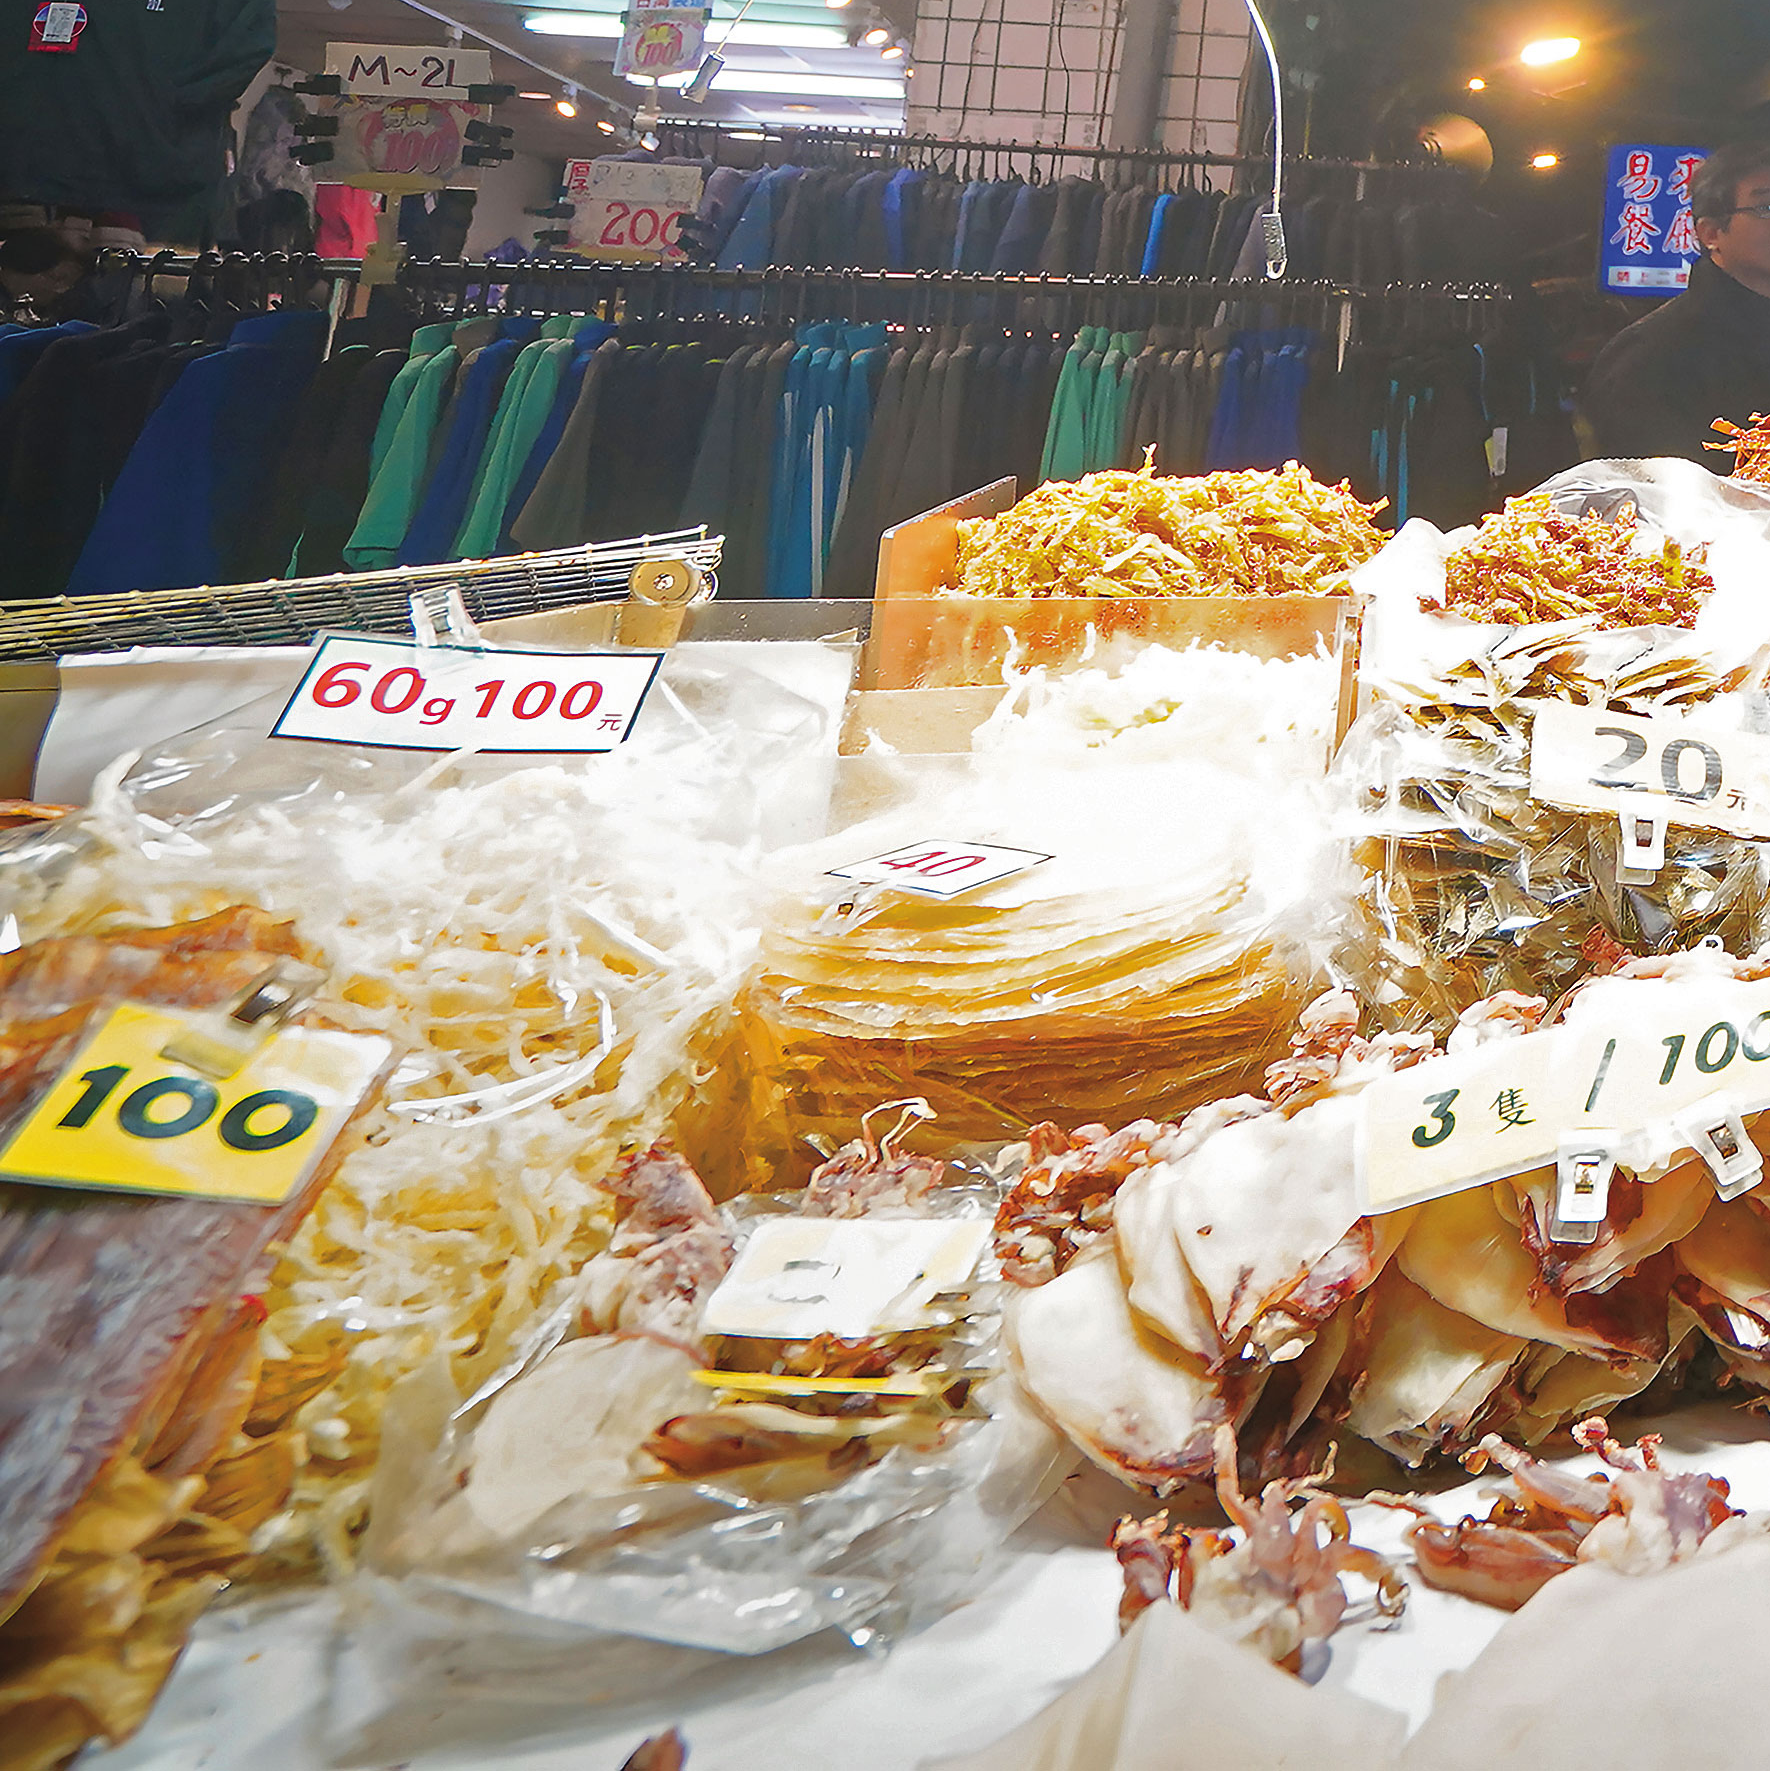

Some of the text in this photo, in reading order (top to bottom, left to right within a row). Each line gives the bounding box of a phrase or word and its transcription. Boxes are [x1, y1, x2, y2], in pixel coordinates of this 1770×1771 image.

[312, 660, 456, 726] 60g
[878, 850, 988, 879] 40
[55, 1064, 321, 1154] 100
